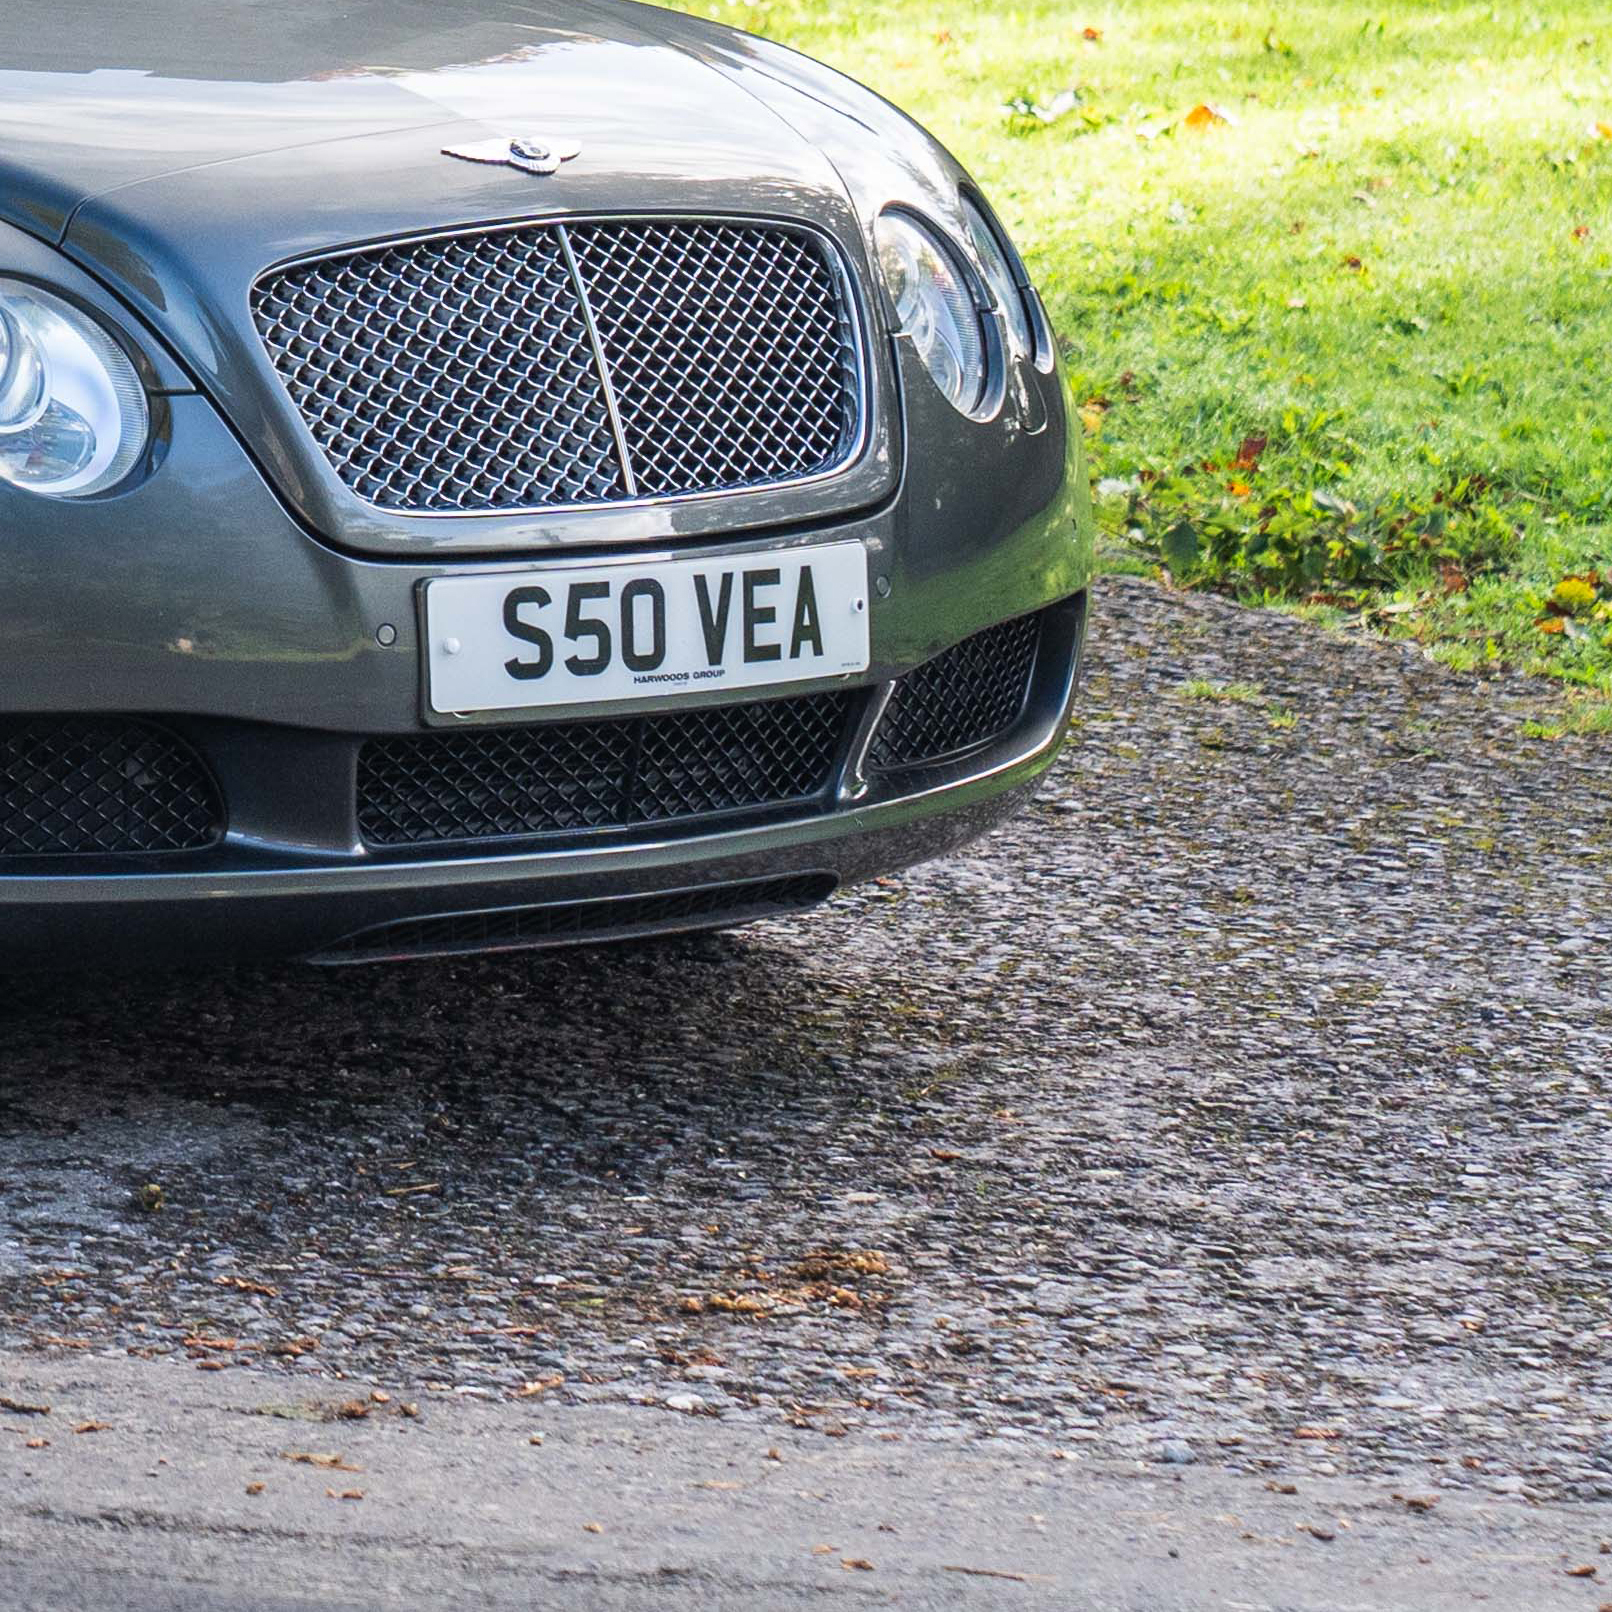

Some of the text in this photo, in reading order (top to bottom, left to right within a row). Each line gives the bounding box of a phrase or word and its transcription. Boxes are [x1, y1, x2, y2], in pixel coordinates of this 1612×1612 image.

[503, 565, 824, 681] S50 VEA
[633, 672, 690, 684] HARWOODS
[693, 669, 726, 680] GROUP
